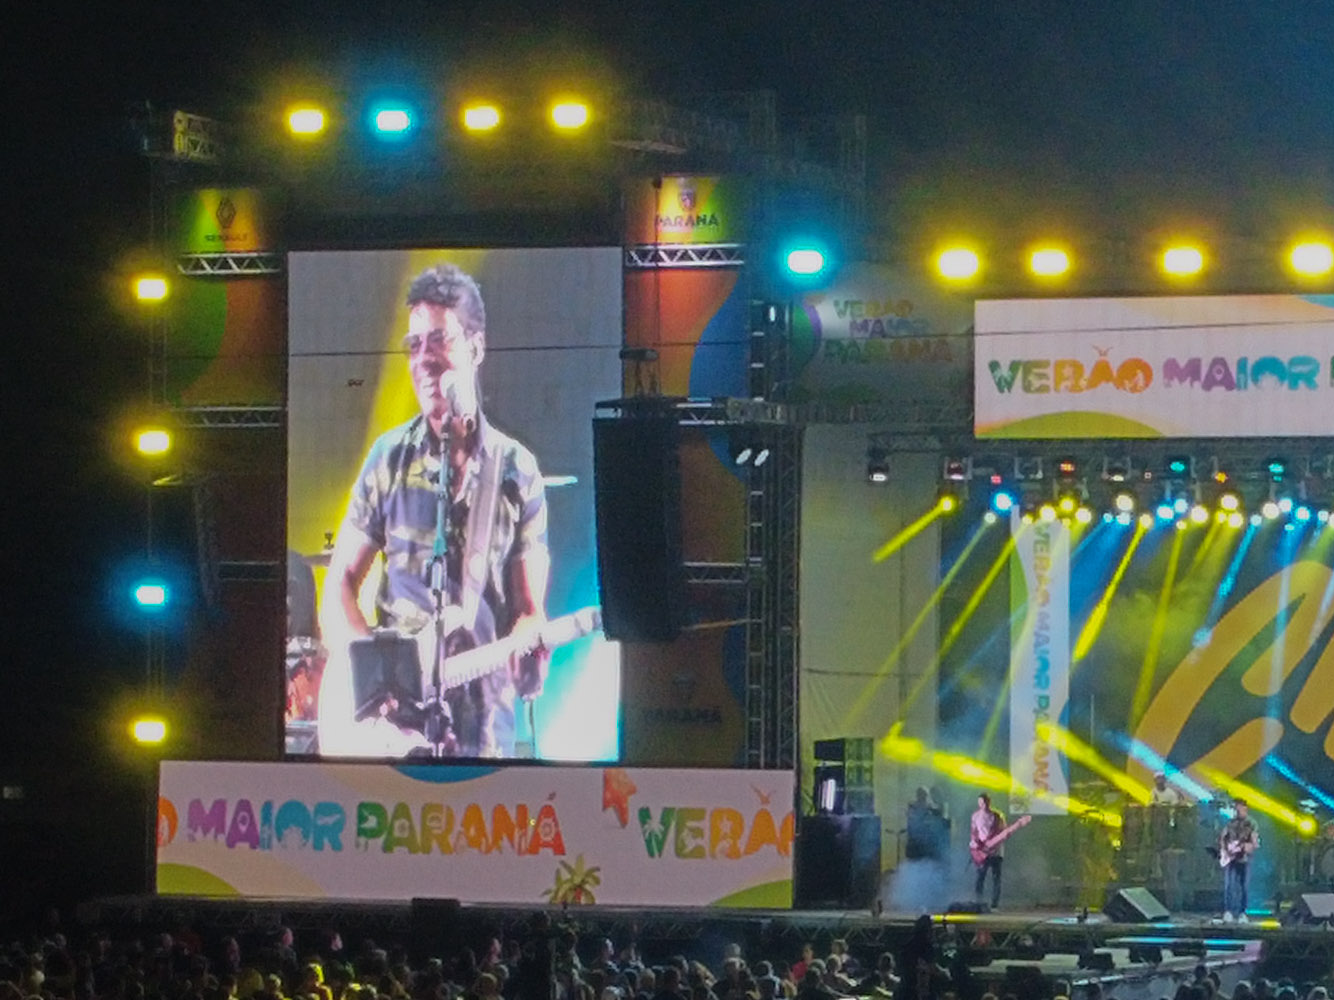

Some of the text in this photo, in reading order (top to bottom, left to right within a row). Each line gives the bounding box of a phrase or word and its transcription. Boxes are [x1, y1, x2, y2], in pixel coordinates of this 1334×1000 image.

[988, 345, 1153, 393] VERÃO
[1163, 355, 1320, 392] MAIOR
[188, 798, 346, 851] MAIOR
[355, 792, 566, 856] PARANÁ
